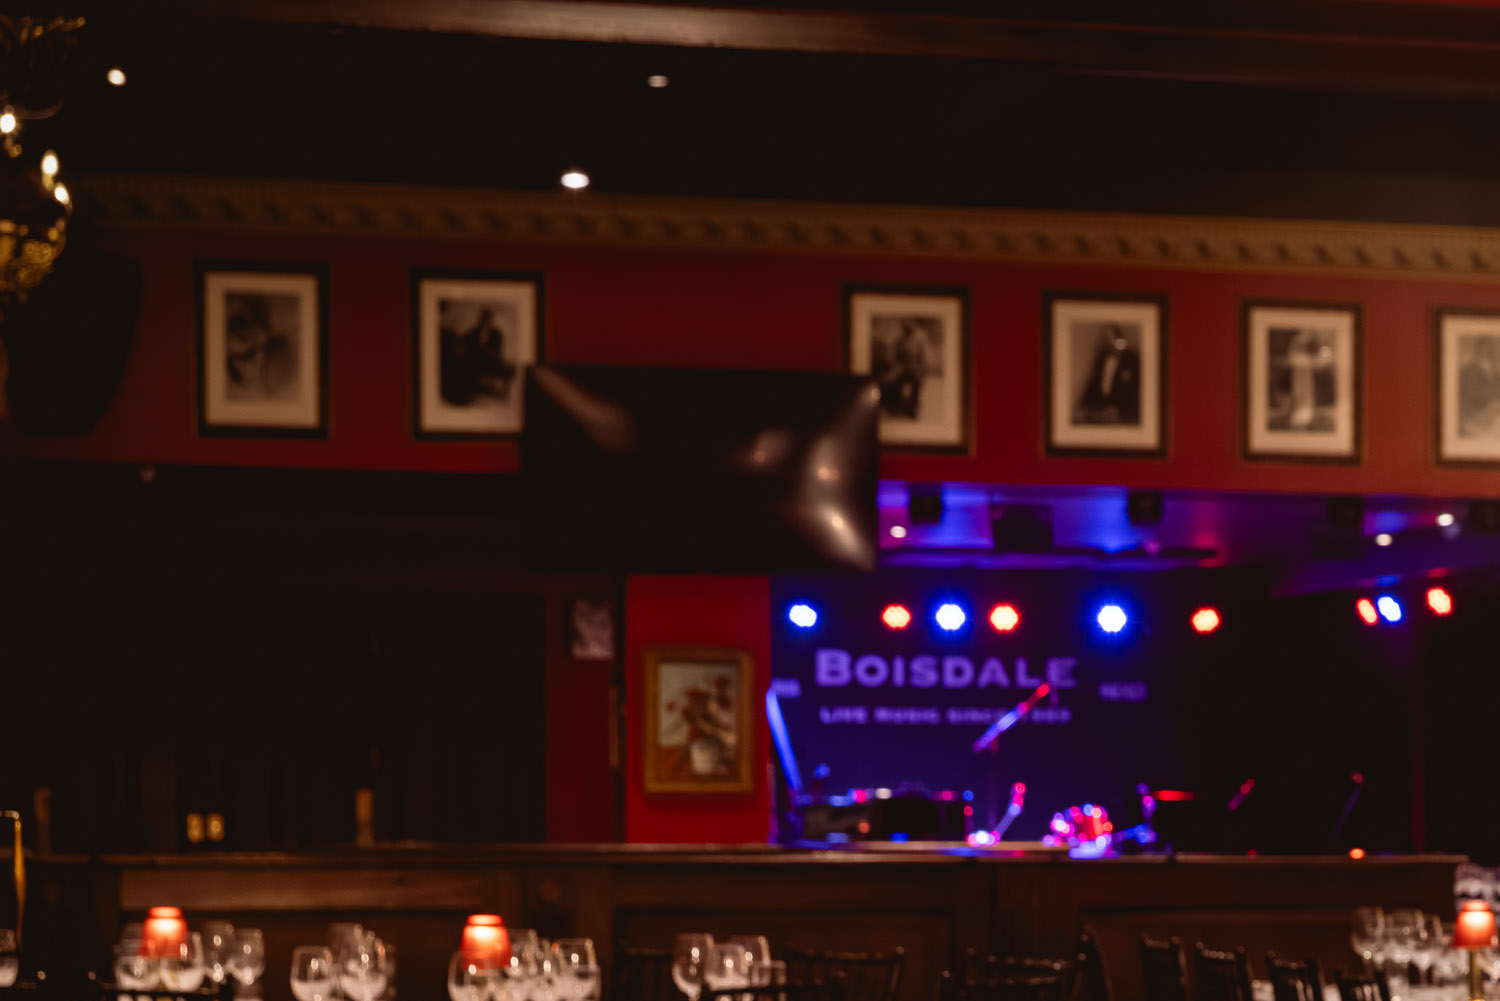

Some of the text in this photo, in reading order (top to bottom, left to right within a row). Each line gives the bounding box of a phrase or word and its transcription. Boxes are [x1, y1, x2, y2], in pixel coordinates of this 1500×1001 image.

[815, 648, 1077, 689] BOISDALE
[819, 705, 868, 724] LIVE
[873, 705, 941, 725] MUSIC
